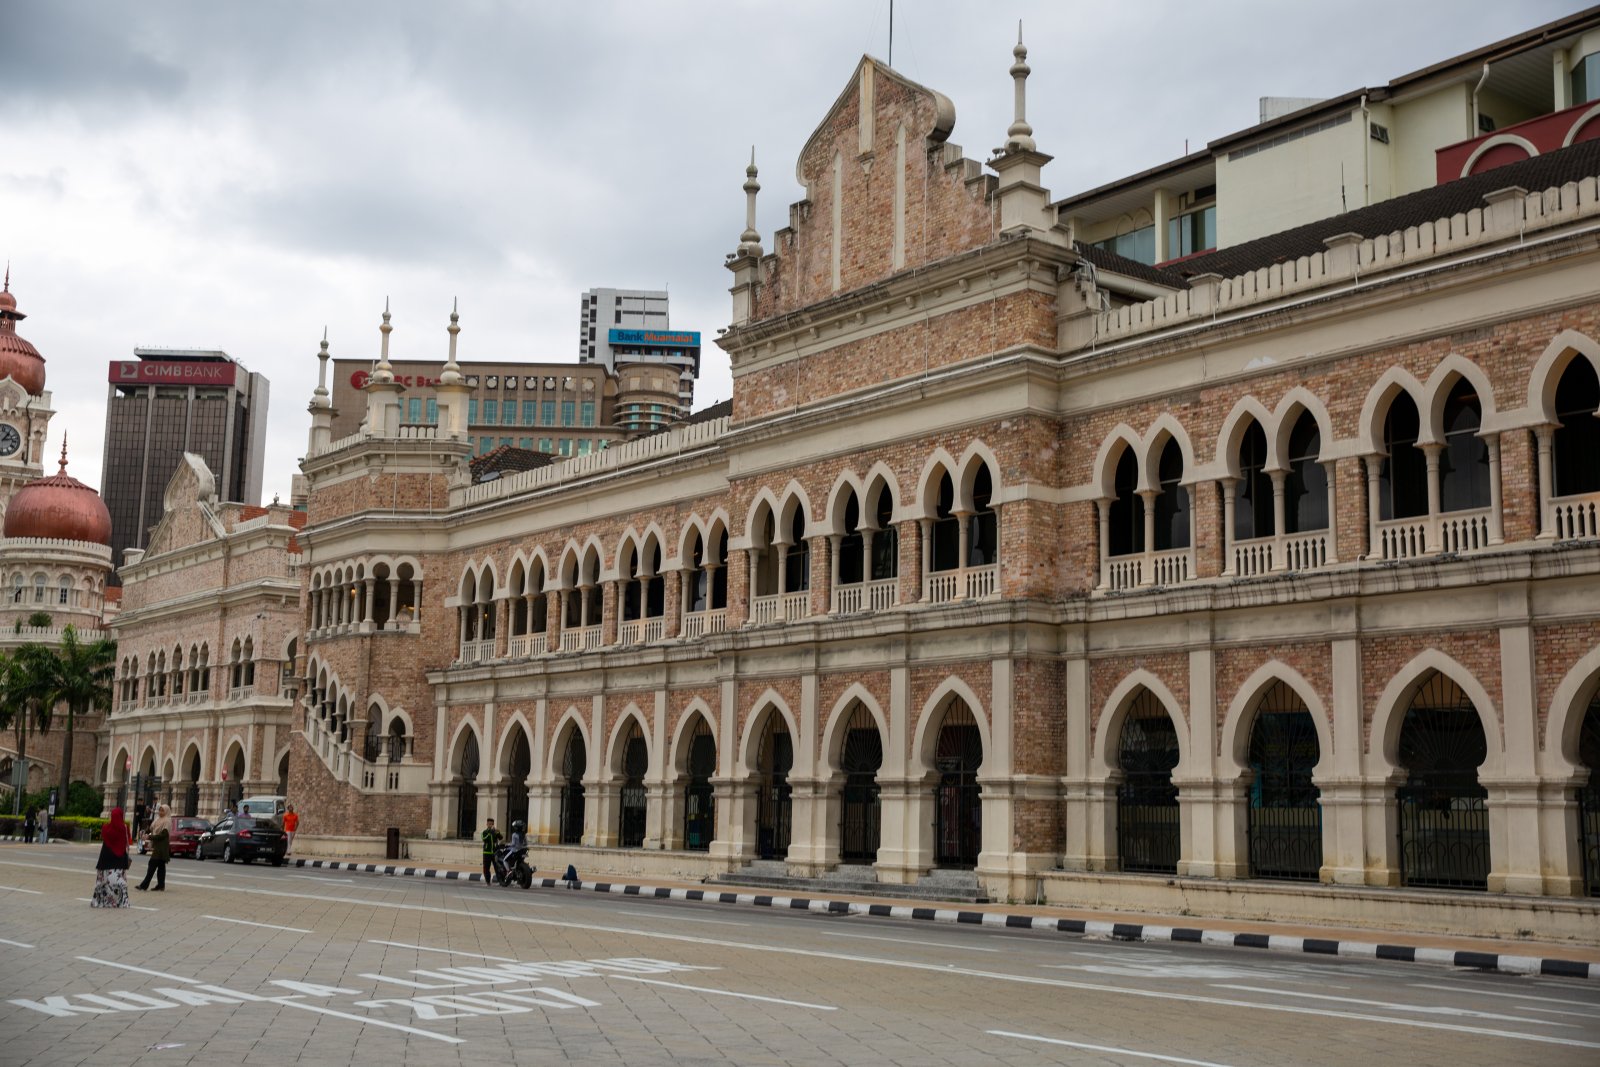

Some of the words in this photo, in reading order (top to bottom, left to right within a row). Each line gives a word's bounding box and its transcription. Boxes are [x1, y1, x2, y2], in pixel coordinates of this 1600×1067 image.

[617, 331, 643, 341] Bank
[644, 331, 693, 343] Muamalat
[144, 364, 182, 377] CIMB
[184, 365, 223, 378] BANK
[5, 979, 364, 1017] KUALA
[357, 957, 721, 989] LUMPUR
[353, 986, 602, 1020] 2017
